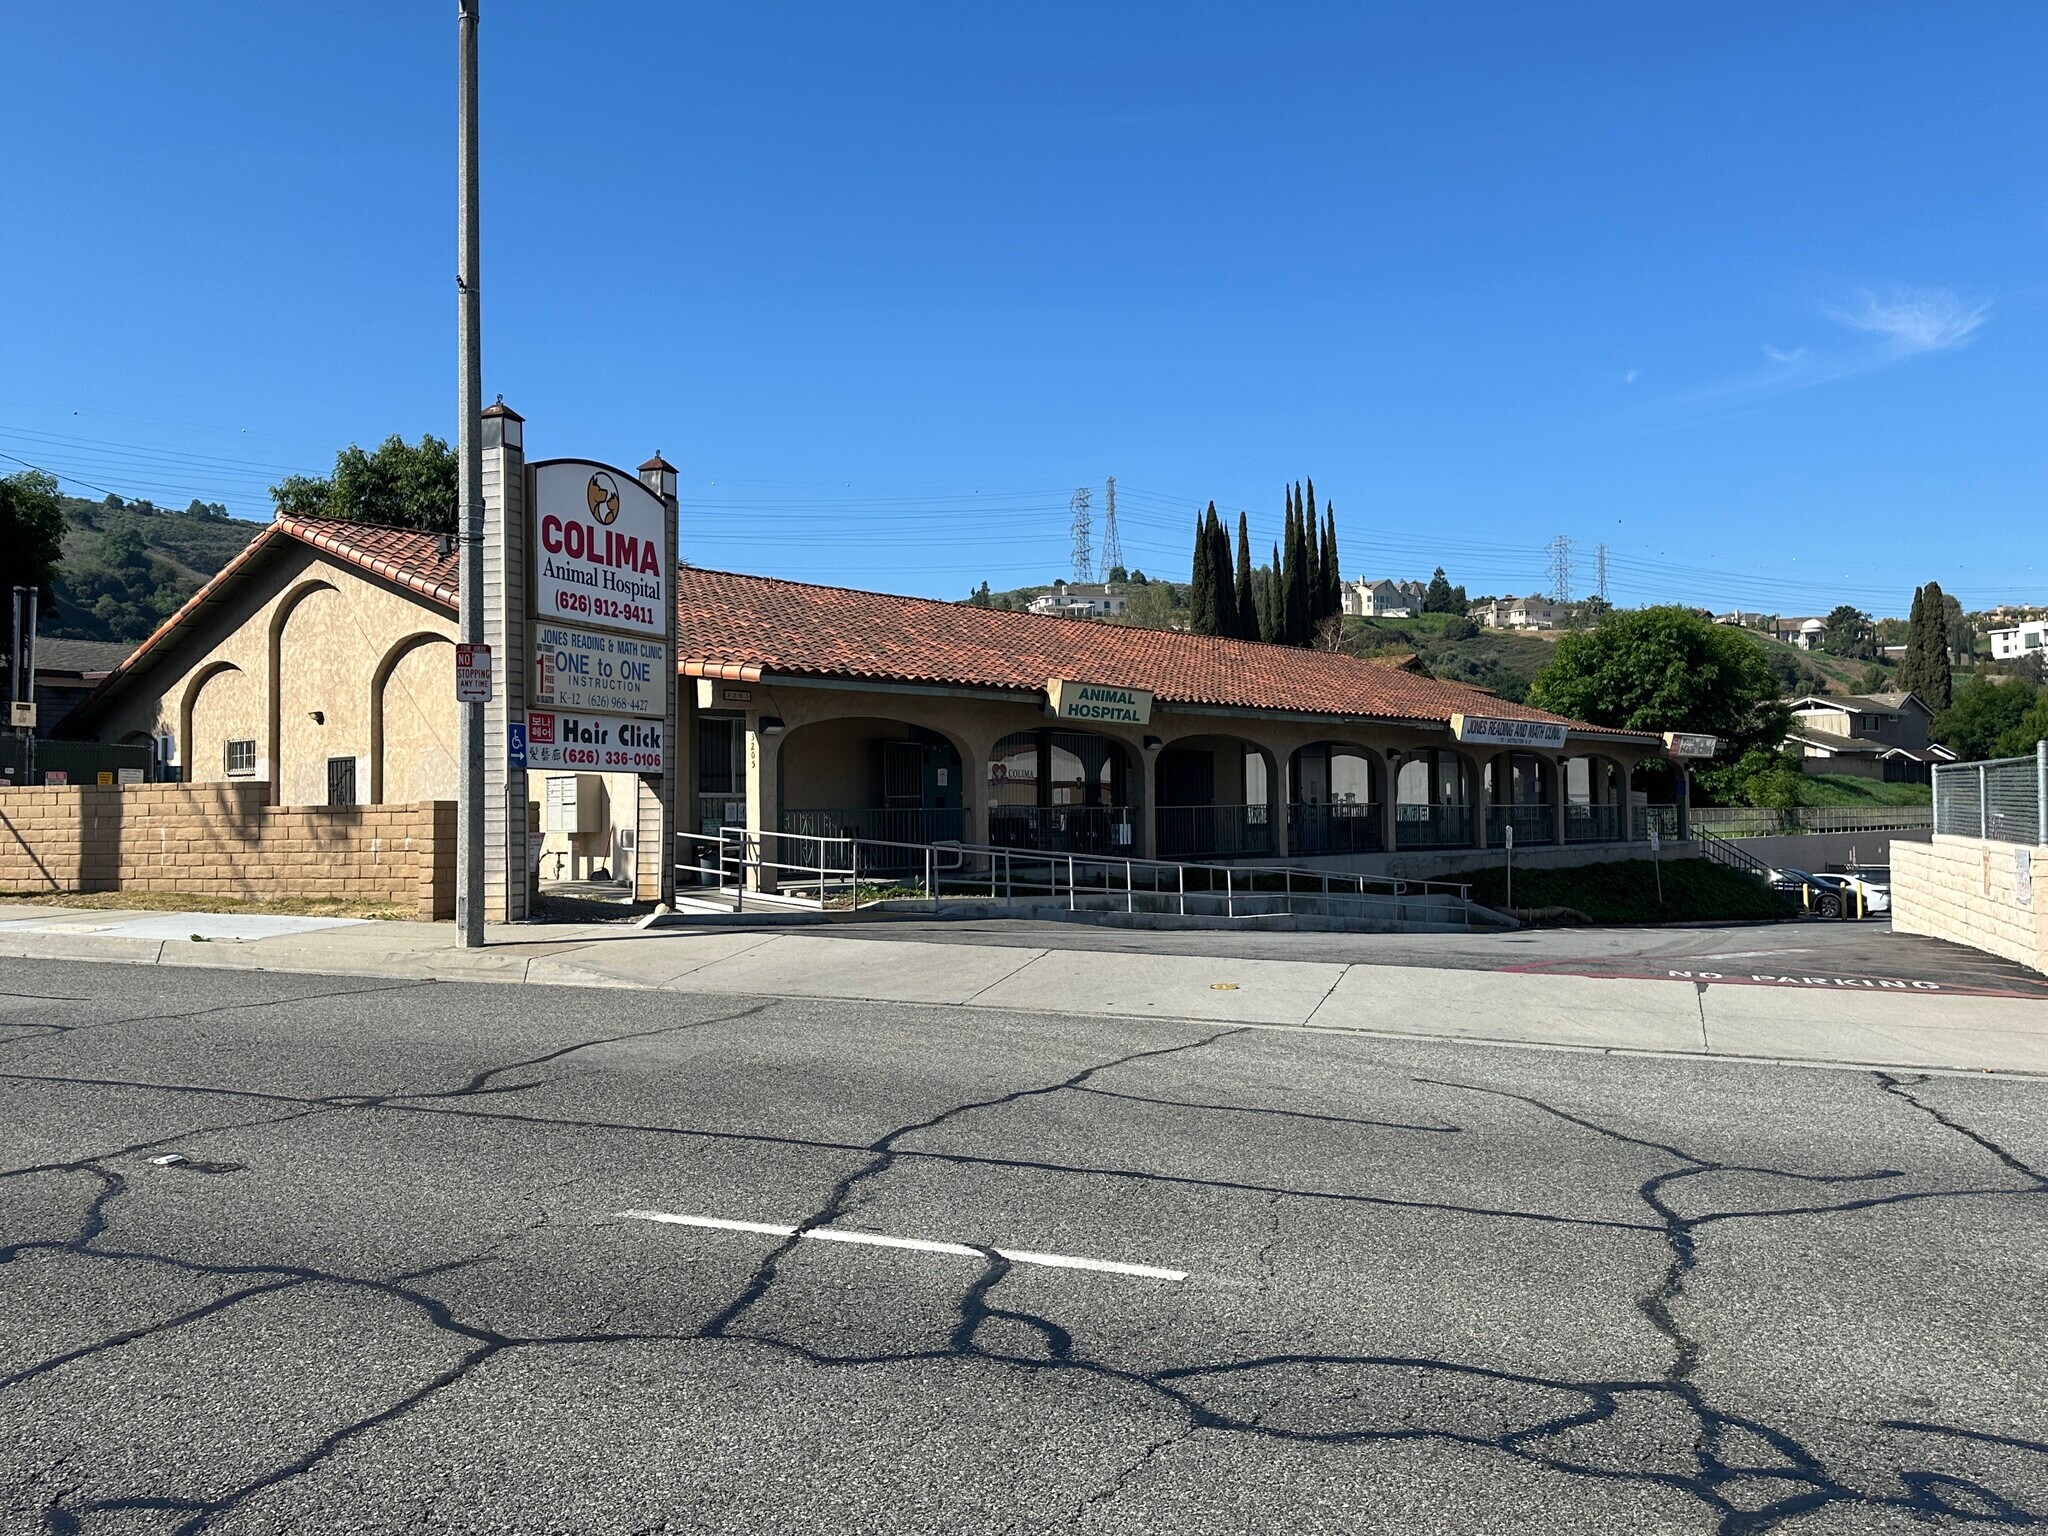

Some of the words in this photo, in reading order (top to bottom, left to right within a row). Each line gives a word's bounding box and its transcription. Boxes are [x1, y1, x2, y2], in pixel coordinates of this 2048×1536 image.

[541, 514, 660, 577] COLIMA
[543, 556, 599, 587] Animal
[602, 569, 661, 602] Hospital
[555, 589, 591, 617] (626)
[594, 597, 654, 624] 912-9411
[541, 629, 568, 646] JONES
[571, 633, 605, 651] READING
[608, 640, 614, 652] &
[617, 641, 638, 656] MATH
[640, 644, 662, 660] CLINIC
[458, 653, 470, 665] NO
[545, 654, 555, 664] FREE
[555, 651, 589, 675] ONE
[597, 658, 613, 677] to
[620, 660, 650, 682] ONE
[457, 669, 490, 679] STOPPING
[536, 654, 544, 693] 1
[545, 664, 555, 673] TEST
[545, 675, 555, 684] FREE
[568, 675, 641, 692] INSTRUCTION
[559, 691, 580, 704] K-12
[587, 692, 609, 709] (626)
[611, 696, 648, 711] 968-4427
[726, 692, 749, 700] 3205
[1078, 687, 1135, 705] ANIMAL
[1068, 703, 1140, 721] HOSPITAL
[531, 716, 551, 727] 보나
[1467, 720, 1488, 734] JONES
[1487, 721, 1514, 737] READING
[1513, 723, 1527, 738] AND
[1527, 724, 1545, 740] MATH
[1544, 726, 1563, 740] CLINIC
[531, 727, 551, 738] 헤어
[563, 719, 608, 745] Hair
[618, 724, 661, 749] Click
[563, 747, 599, 765] (626)
[605, 751, 661, 767] 336-0106
[1008, 769, 1034, 778] COLIMA
[1669, 970, 1723, 980] NO
[1751, 974, 1940, 990] PARKING
